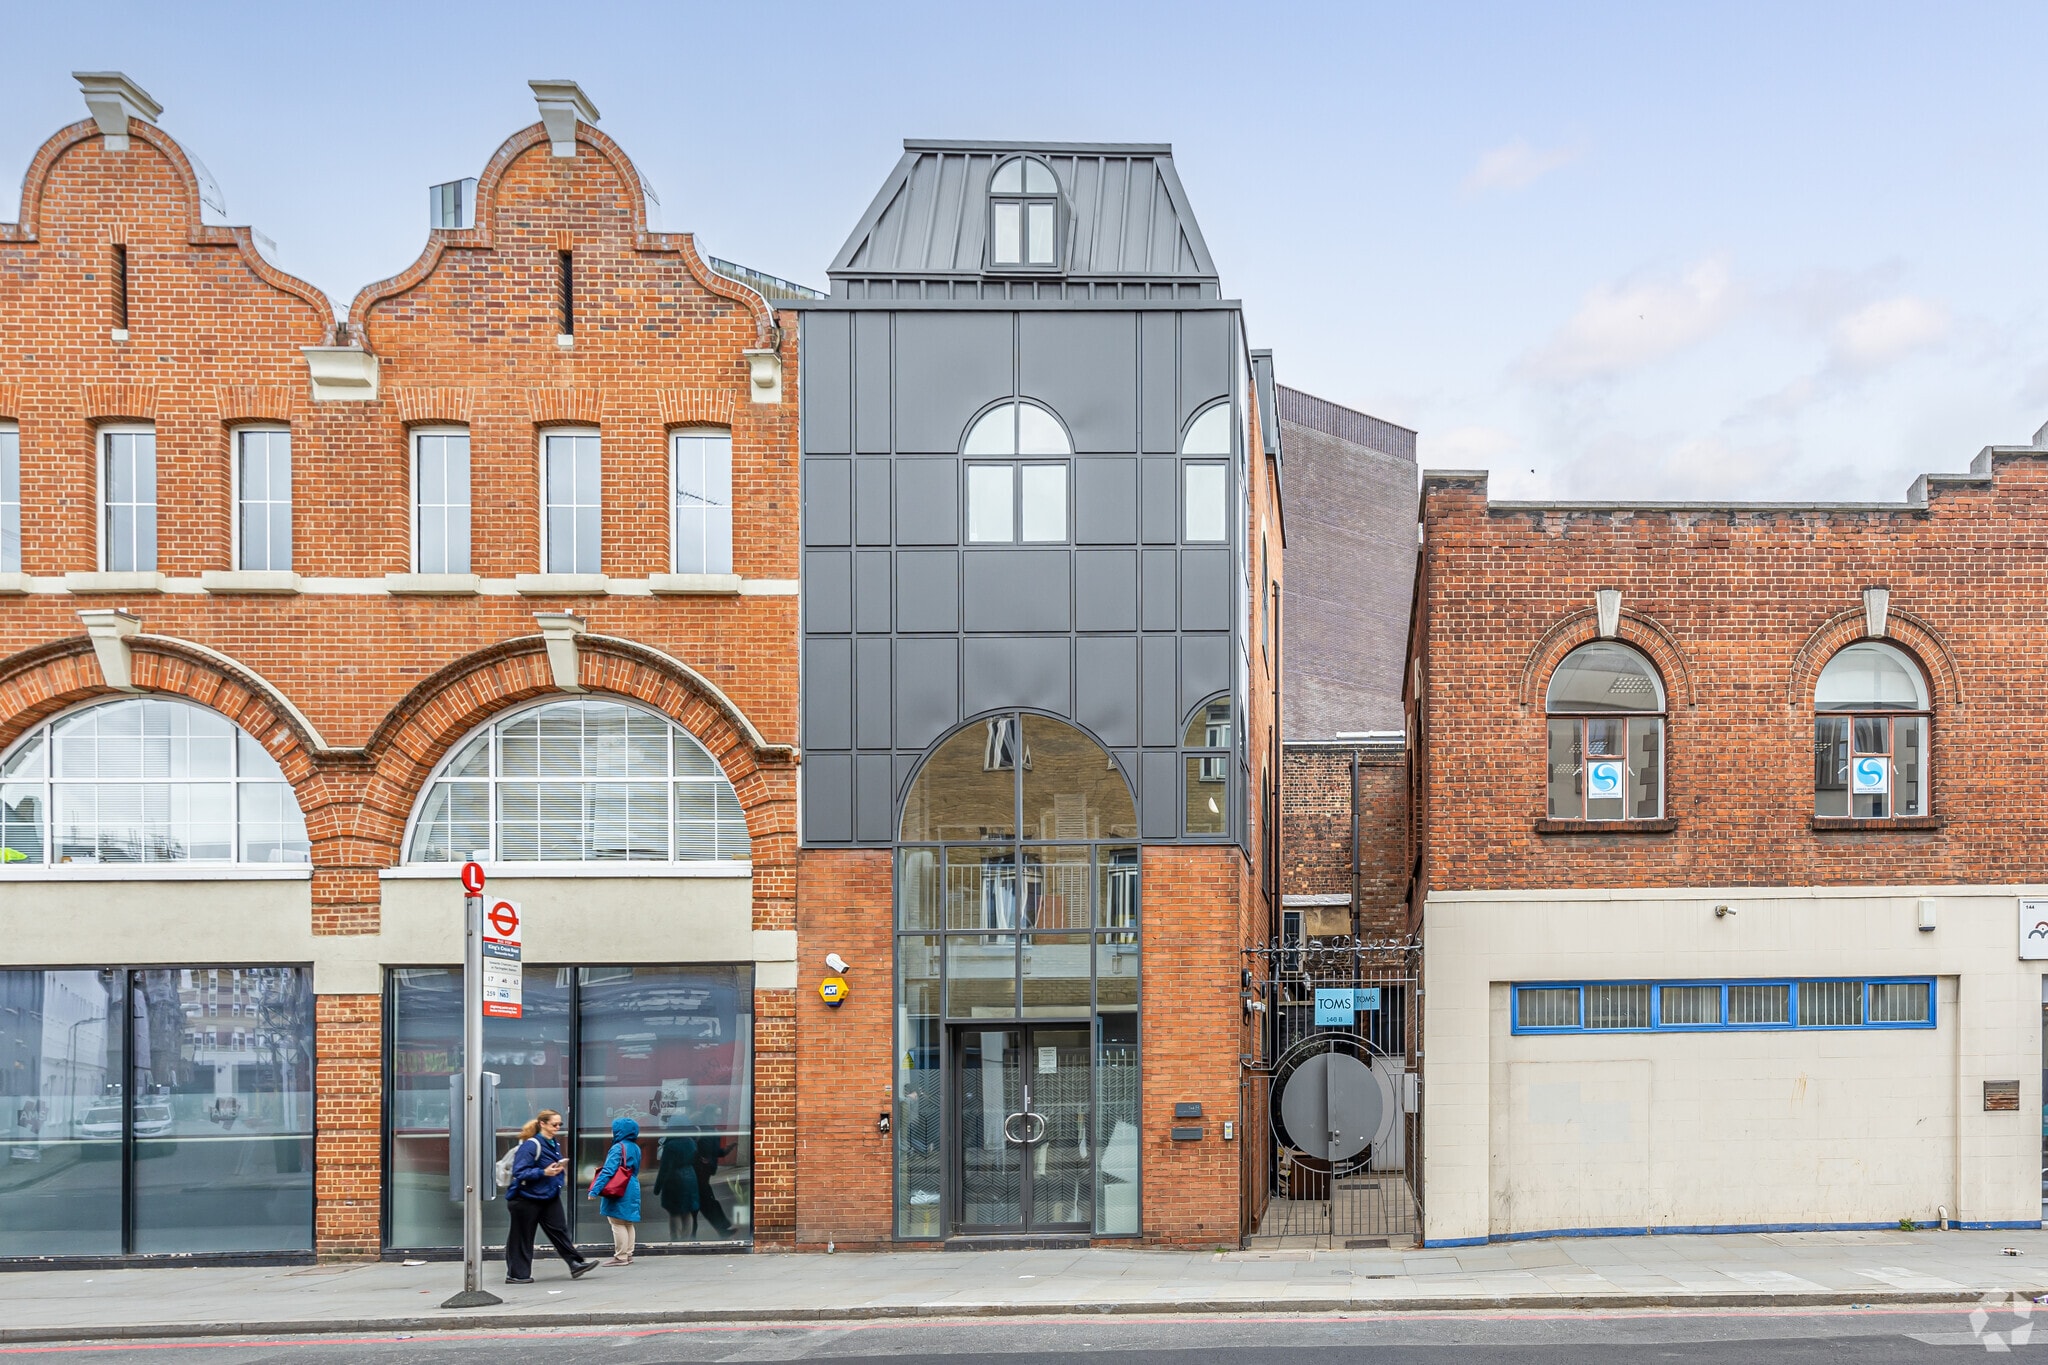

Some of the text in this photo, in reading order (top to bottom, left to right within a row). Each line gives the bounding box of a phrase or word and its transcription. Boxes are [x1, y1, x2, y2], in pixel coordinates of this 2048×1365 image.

[470, 866, 482, 889] L
[1318, 998, 1352, 1009] TOMS
[1356, 995, 1376, 1003] TOMS
[651, 1100, 676, 1110] AMS
[19, 1110, 48, 1121] AMS
[212, 1107, 238, 1118] AMS
